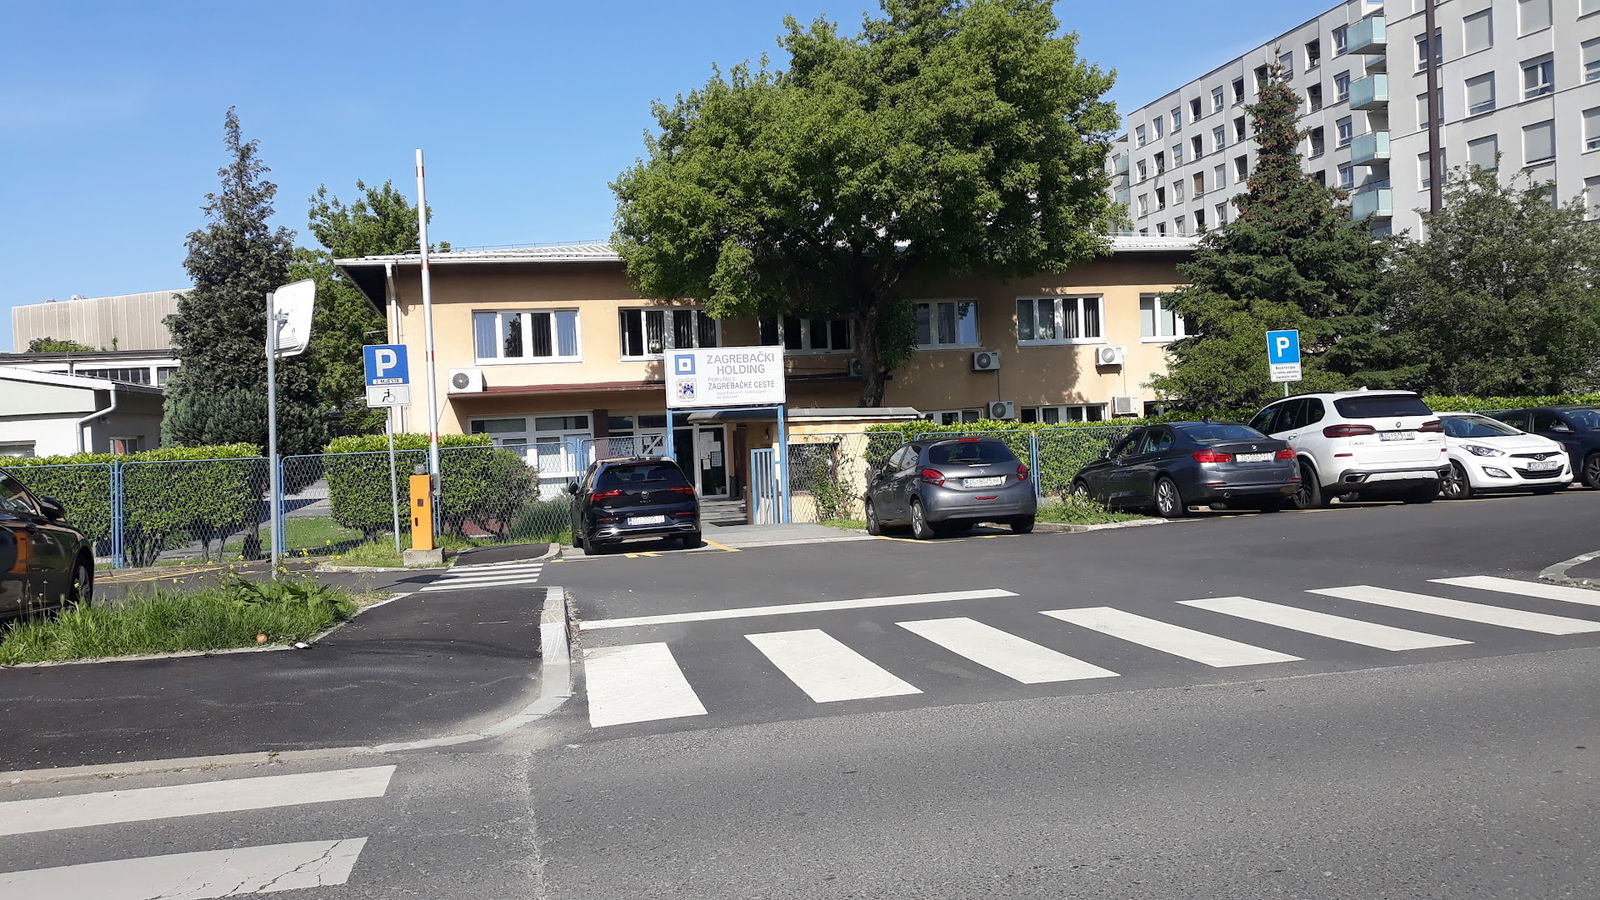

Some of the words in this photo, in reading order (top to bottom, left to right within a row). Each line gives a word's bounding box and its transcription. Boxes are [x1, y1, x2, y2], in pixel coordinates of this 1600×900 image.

[1276, 336, 1290, 358] P
[375, 348, 397, 377] P
[706, 351, 775, 364] ZAGREBAČKI
[716, 364, 766, 375] HOLDING
[708, 381, 753, 390] ZAGREBAČKE
[753, 380, 775, 389] CESTE
